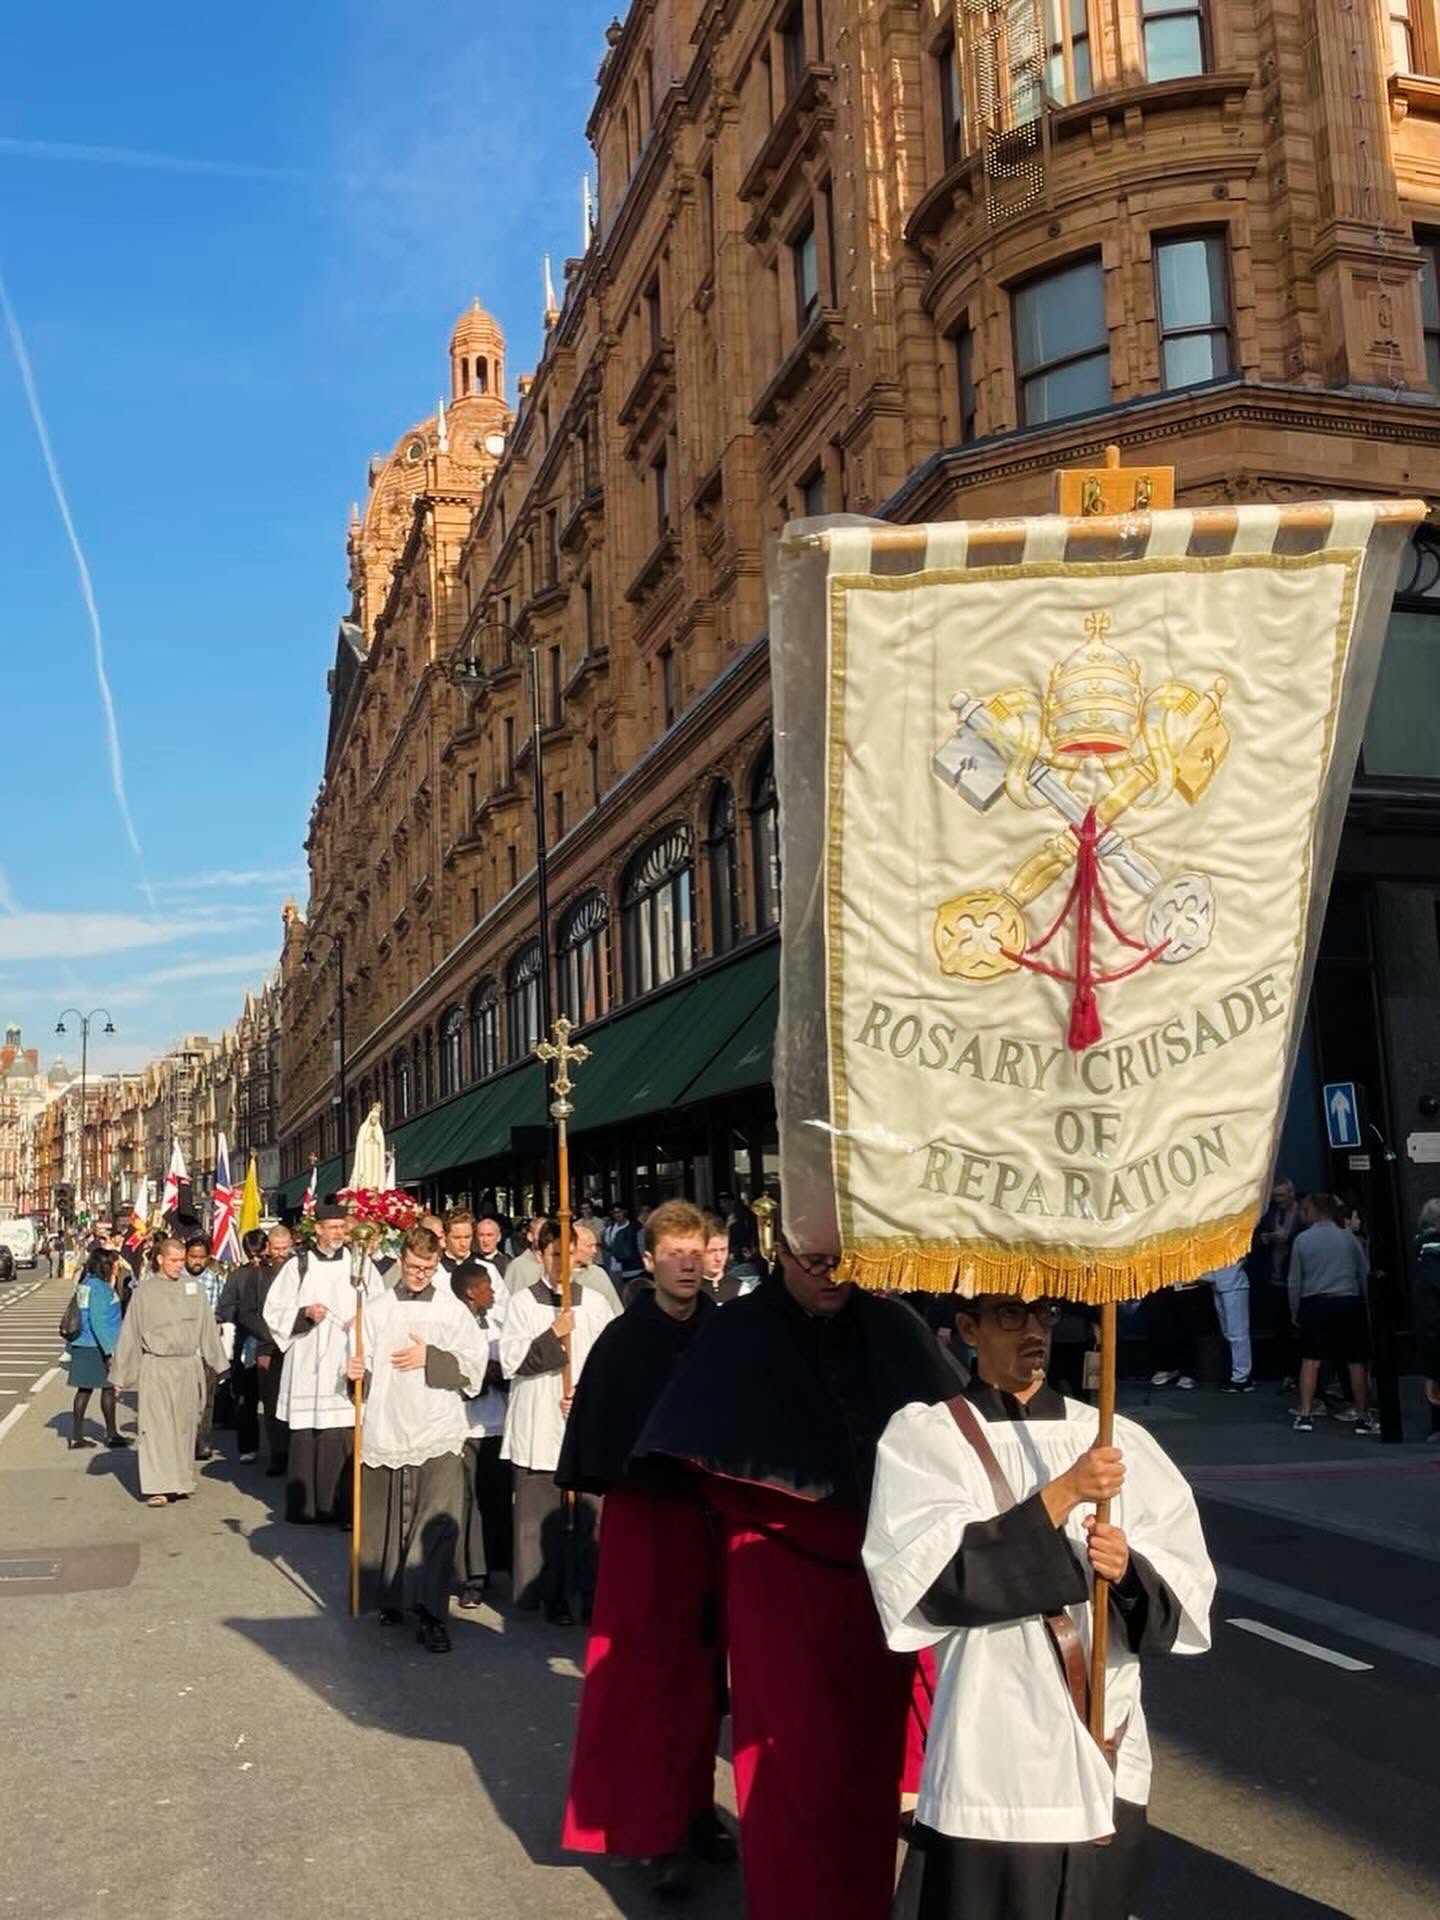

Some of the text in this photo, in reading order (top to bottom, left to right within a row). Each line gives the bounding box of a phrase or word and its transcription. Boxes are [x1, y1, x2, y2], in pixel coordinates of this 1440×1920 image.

[853, 973, 1284, 1096] ROSARY CRUSADE
[917, 1123, 1232, 1221] REPARATION
[1054, 1110, 1122, 1157] OF
